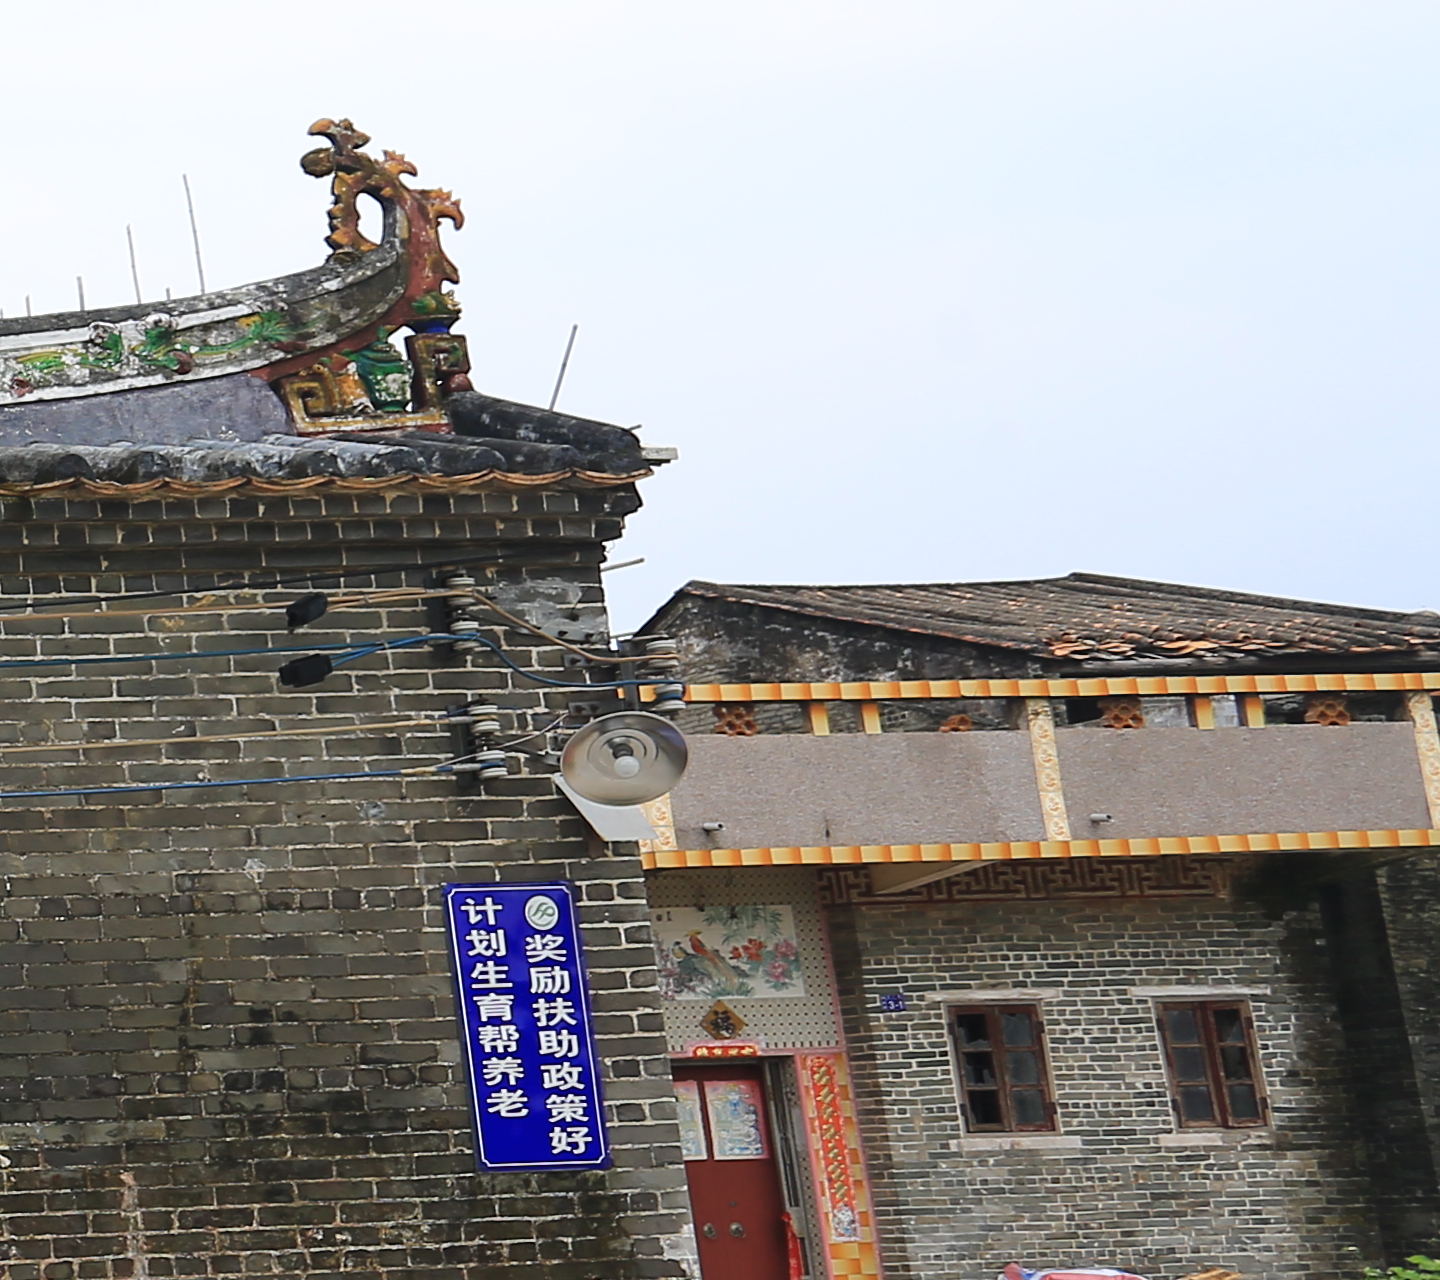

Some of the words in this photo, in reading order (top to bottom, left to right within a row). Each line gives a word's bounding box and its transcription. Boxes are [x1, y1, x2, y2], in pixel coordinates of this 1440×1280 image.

[460, 896, 529, 1119] 计划生育帮养老
[525, 934, 592, 1156] 奖励扶助政策好
